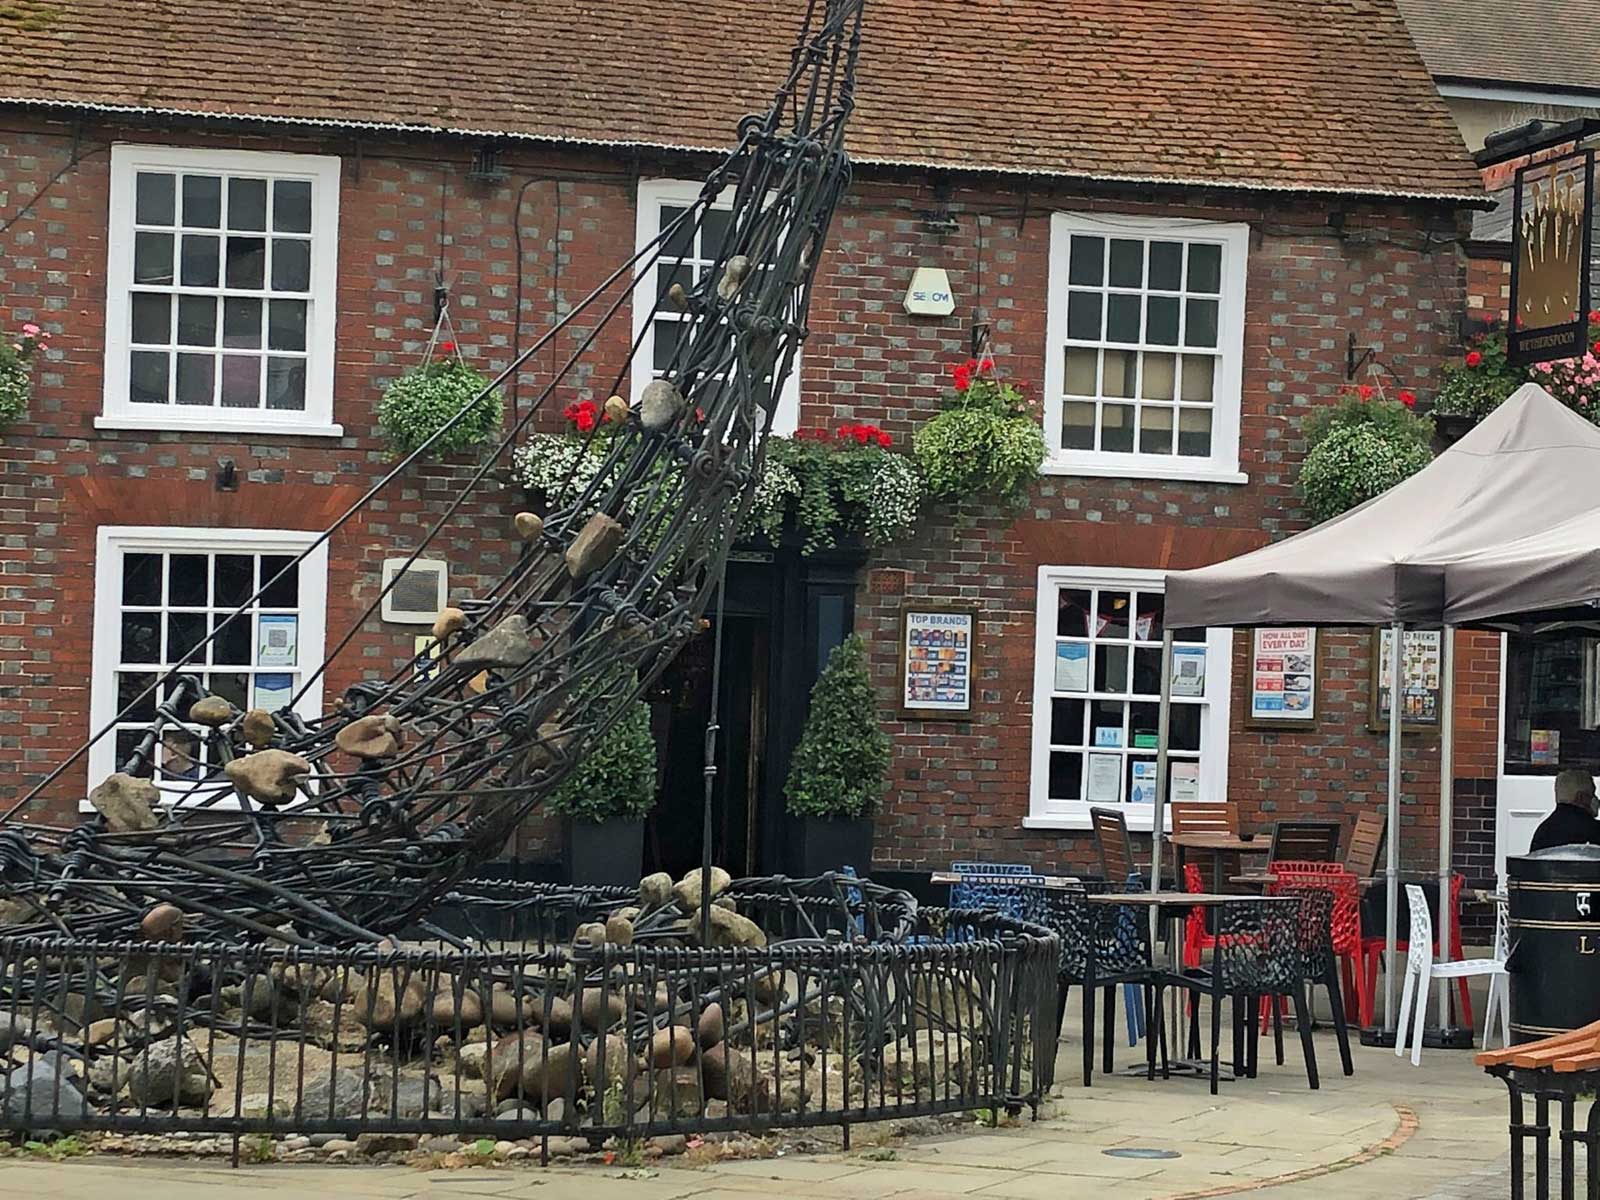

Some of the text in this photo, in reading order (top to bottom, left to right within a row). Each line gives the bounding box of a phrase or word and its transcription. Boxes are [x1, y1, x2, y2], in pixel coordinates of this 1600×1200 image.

[913, 291, 949, 302] SEOM
[910, 615, 968, 625] TOP BRANDS
[1263, 640, 1306, 649] EVERY DAY
